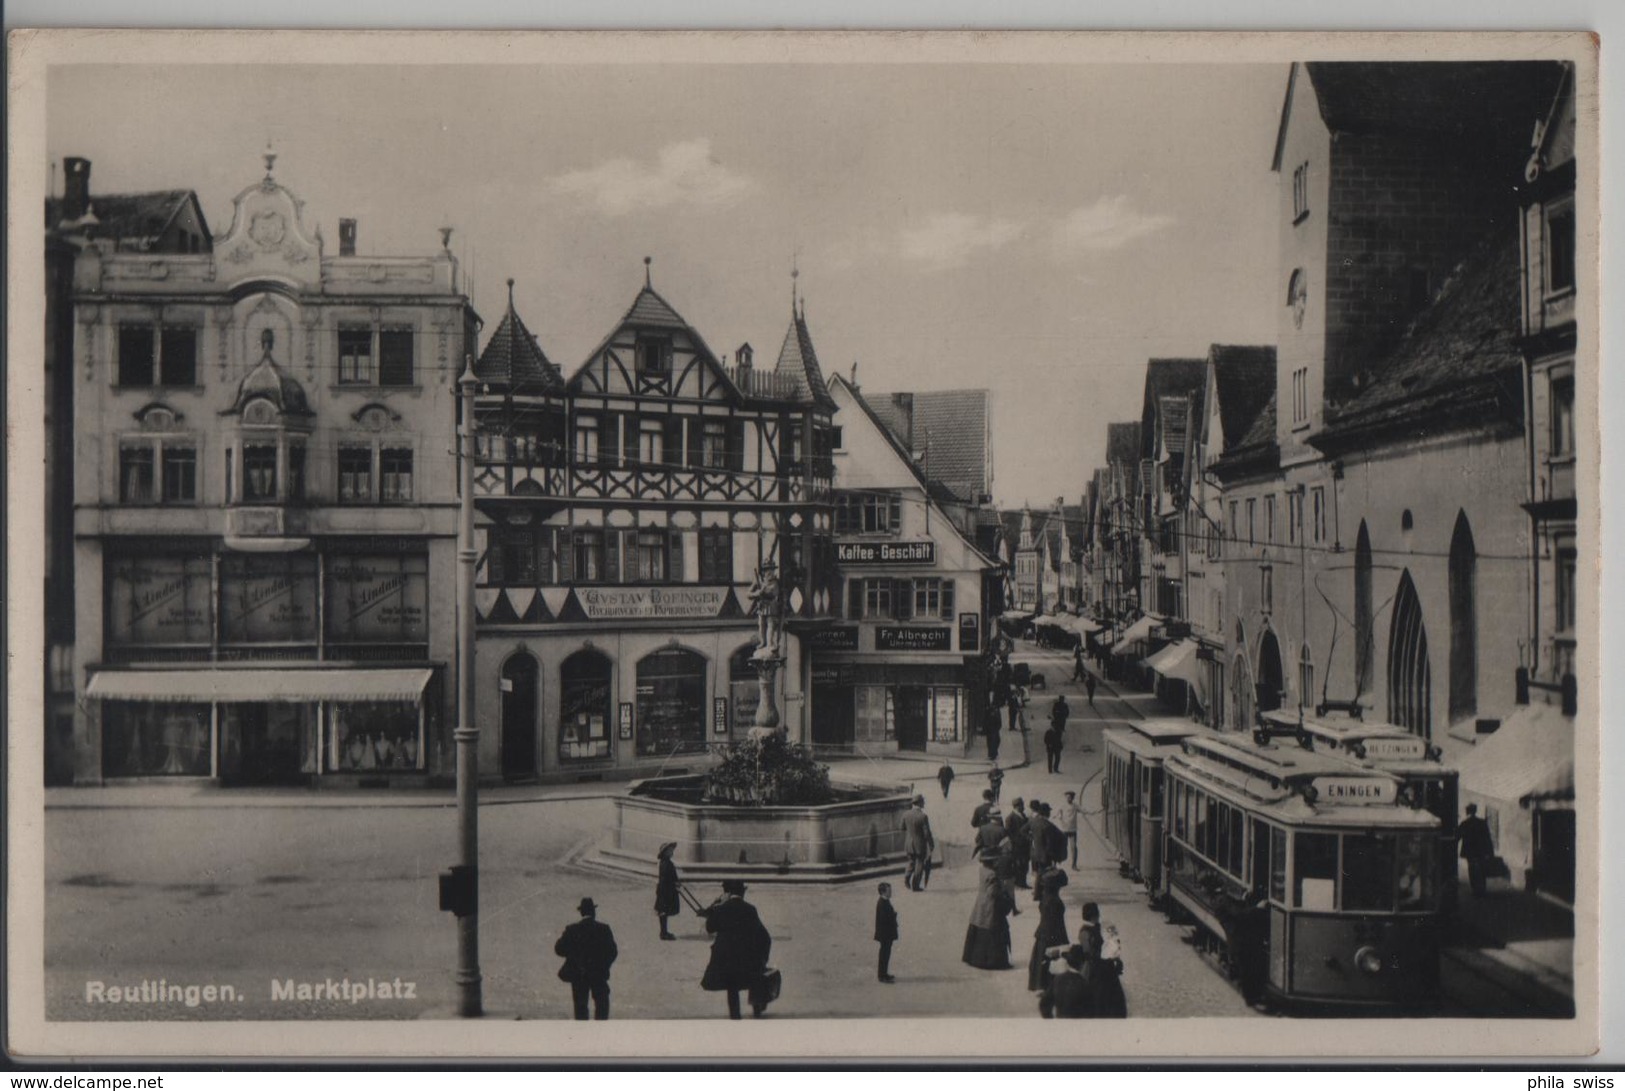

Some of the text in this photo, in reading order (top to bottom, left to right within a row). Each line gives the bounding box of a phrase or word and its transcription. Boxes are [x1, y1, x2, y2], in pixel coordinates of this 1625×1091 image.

[897, 629, 946, 641] Albrecht
[889, 639, 936, 648] Uhrmacher
[1328, 784, 1381, 797] ENINGEN
